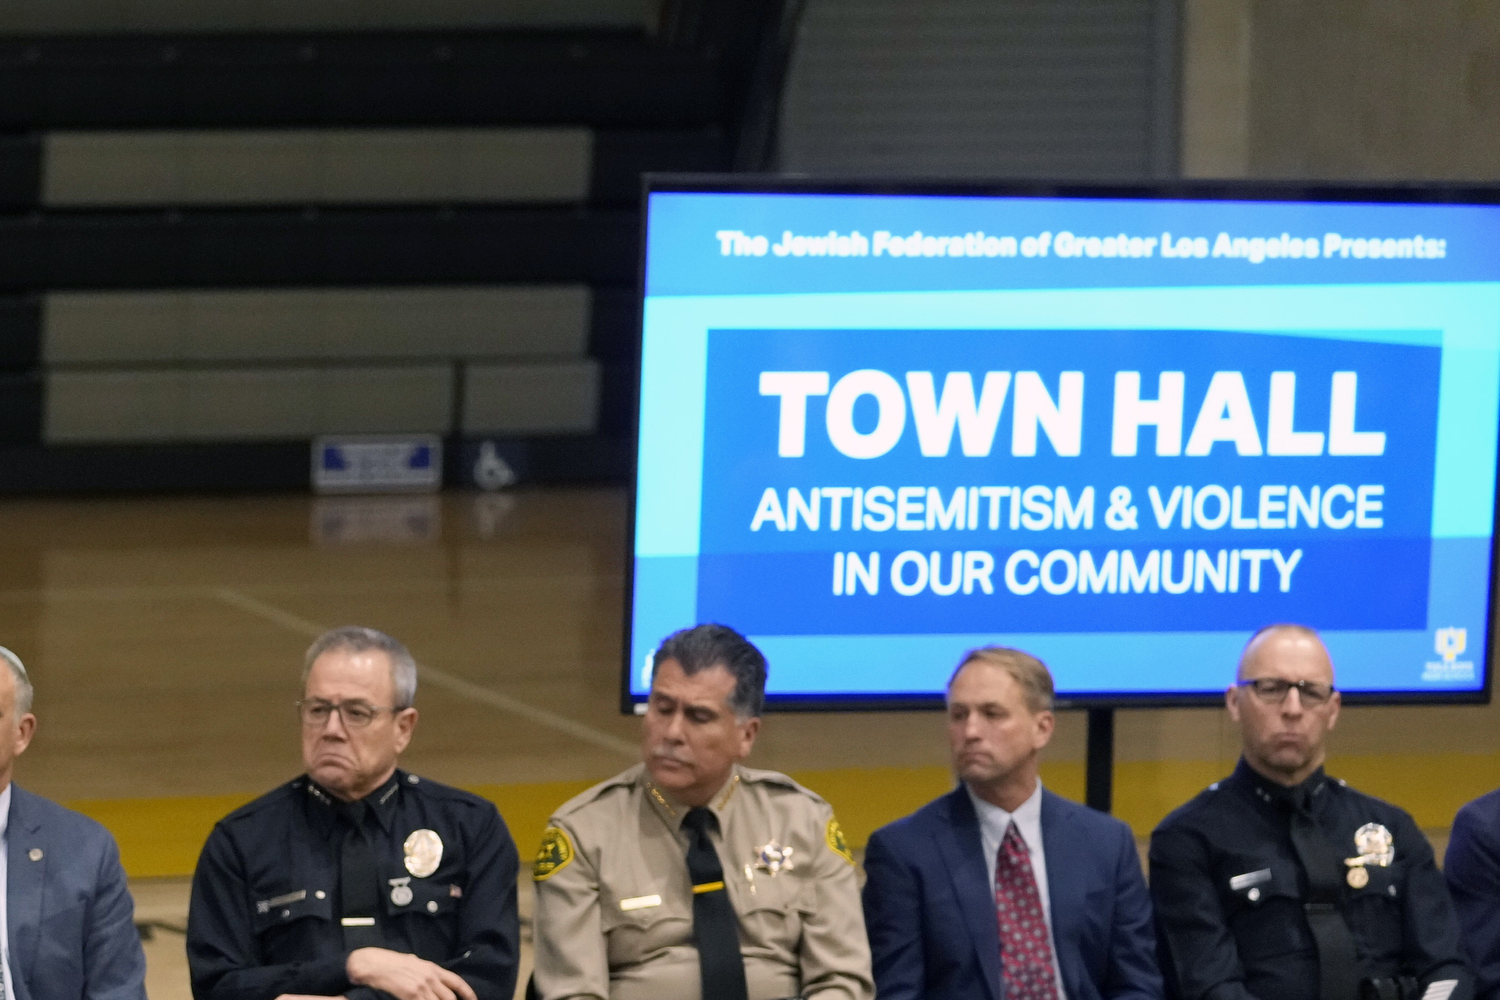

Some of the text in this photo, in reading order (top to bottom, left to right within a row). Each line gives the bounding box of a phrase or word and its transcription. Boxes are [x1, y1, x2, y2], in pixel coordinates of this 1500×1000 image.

[717, 229, 1446, 264] The Jewish Federation of Greater Los Angeles Presents:
[759, 369, 1386, 459] TOWN HALL
[750, 484, 1384, 533] ANTISEMITISM & VIOLENCE
[832, 548, 1303, 596] IN OUR COMMUNITY
